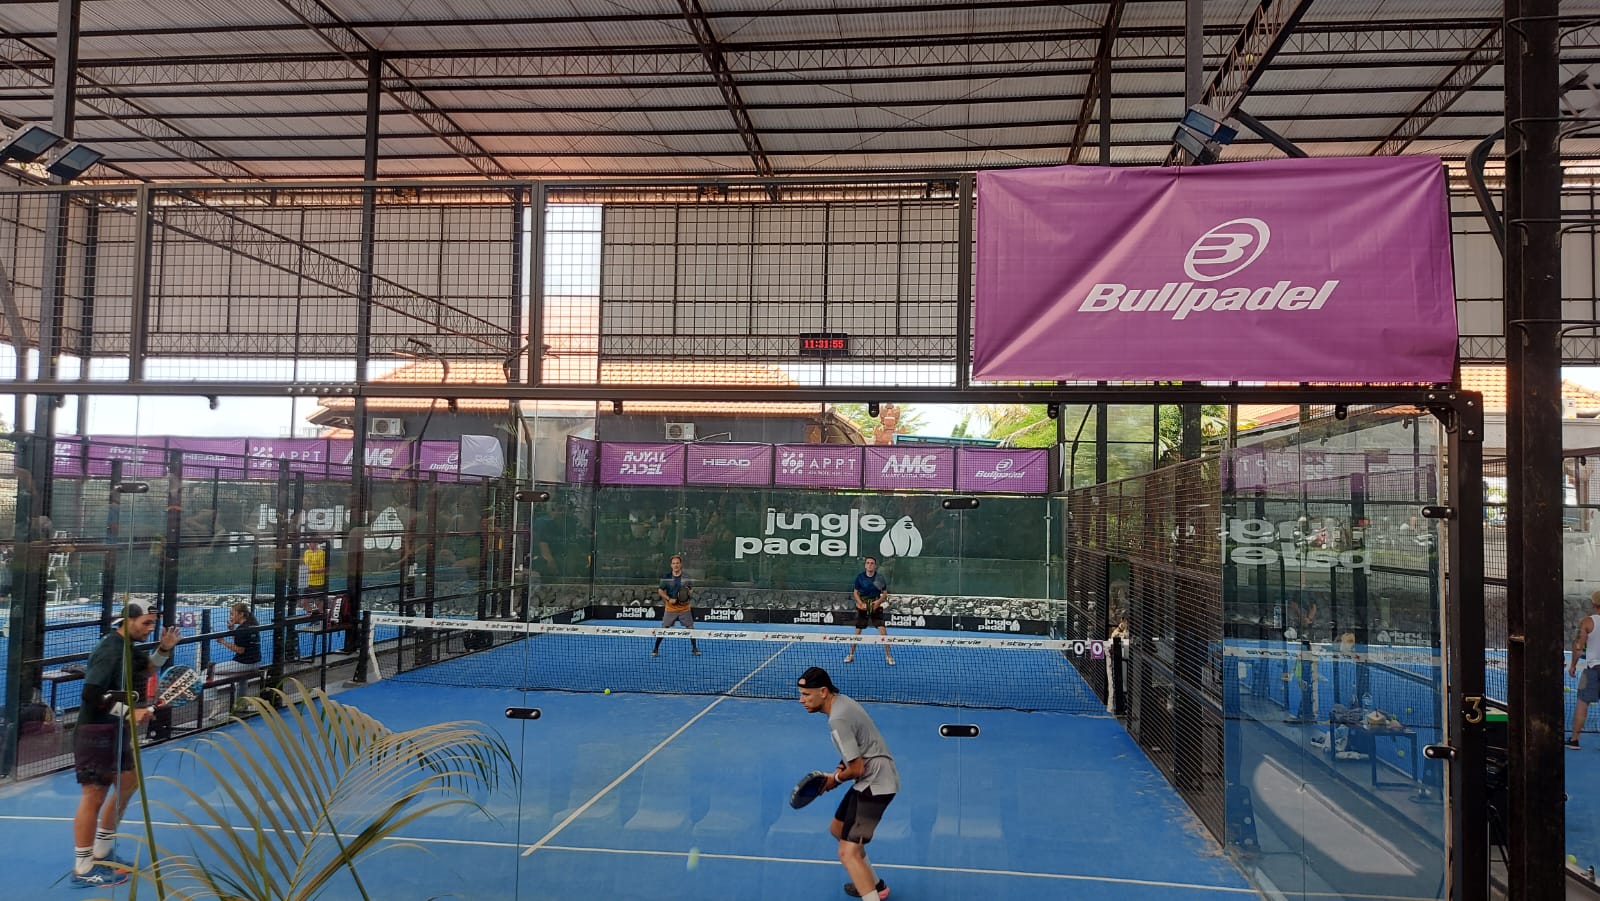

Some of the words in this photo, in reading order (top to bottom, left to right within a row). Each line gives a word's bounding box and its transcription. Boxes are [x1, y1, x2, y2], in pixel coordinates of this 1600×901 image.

[1077, 280, 1340, 320] Bullpadel
[623, 450, 666, 463] ROYAL
[702, 458, 751, 467] HEAD
[619, 463, 663, 475] PADEL
[809, 457, 856, 470] APPT
[881, 454, 937, 474] AMG
[975, 470, 1026, 479] Bullpadel
[765, 507, 887, 538] jungle
[735, 532, 859, 559] padel
[1074, 642, 1084, 655] 0
[1092, 642, 1103, 655] 0
[1465, 696, 1483, 724] 3
